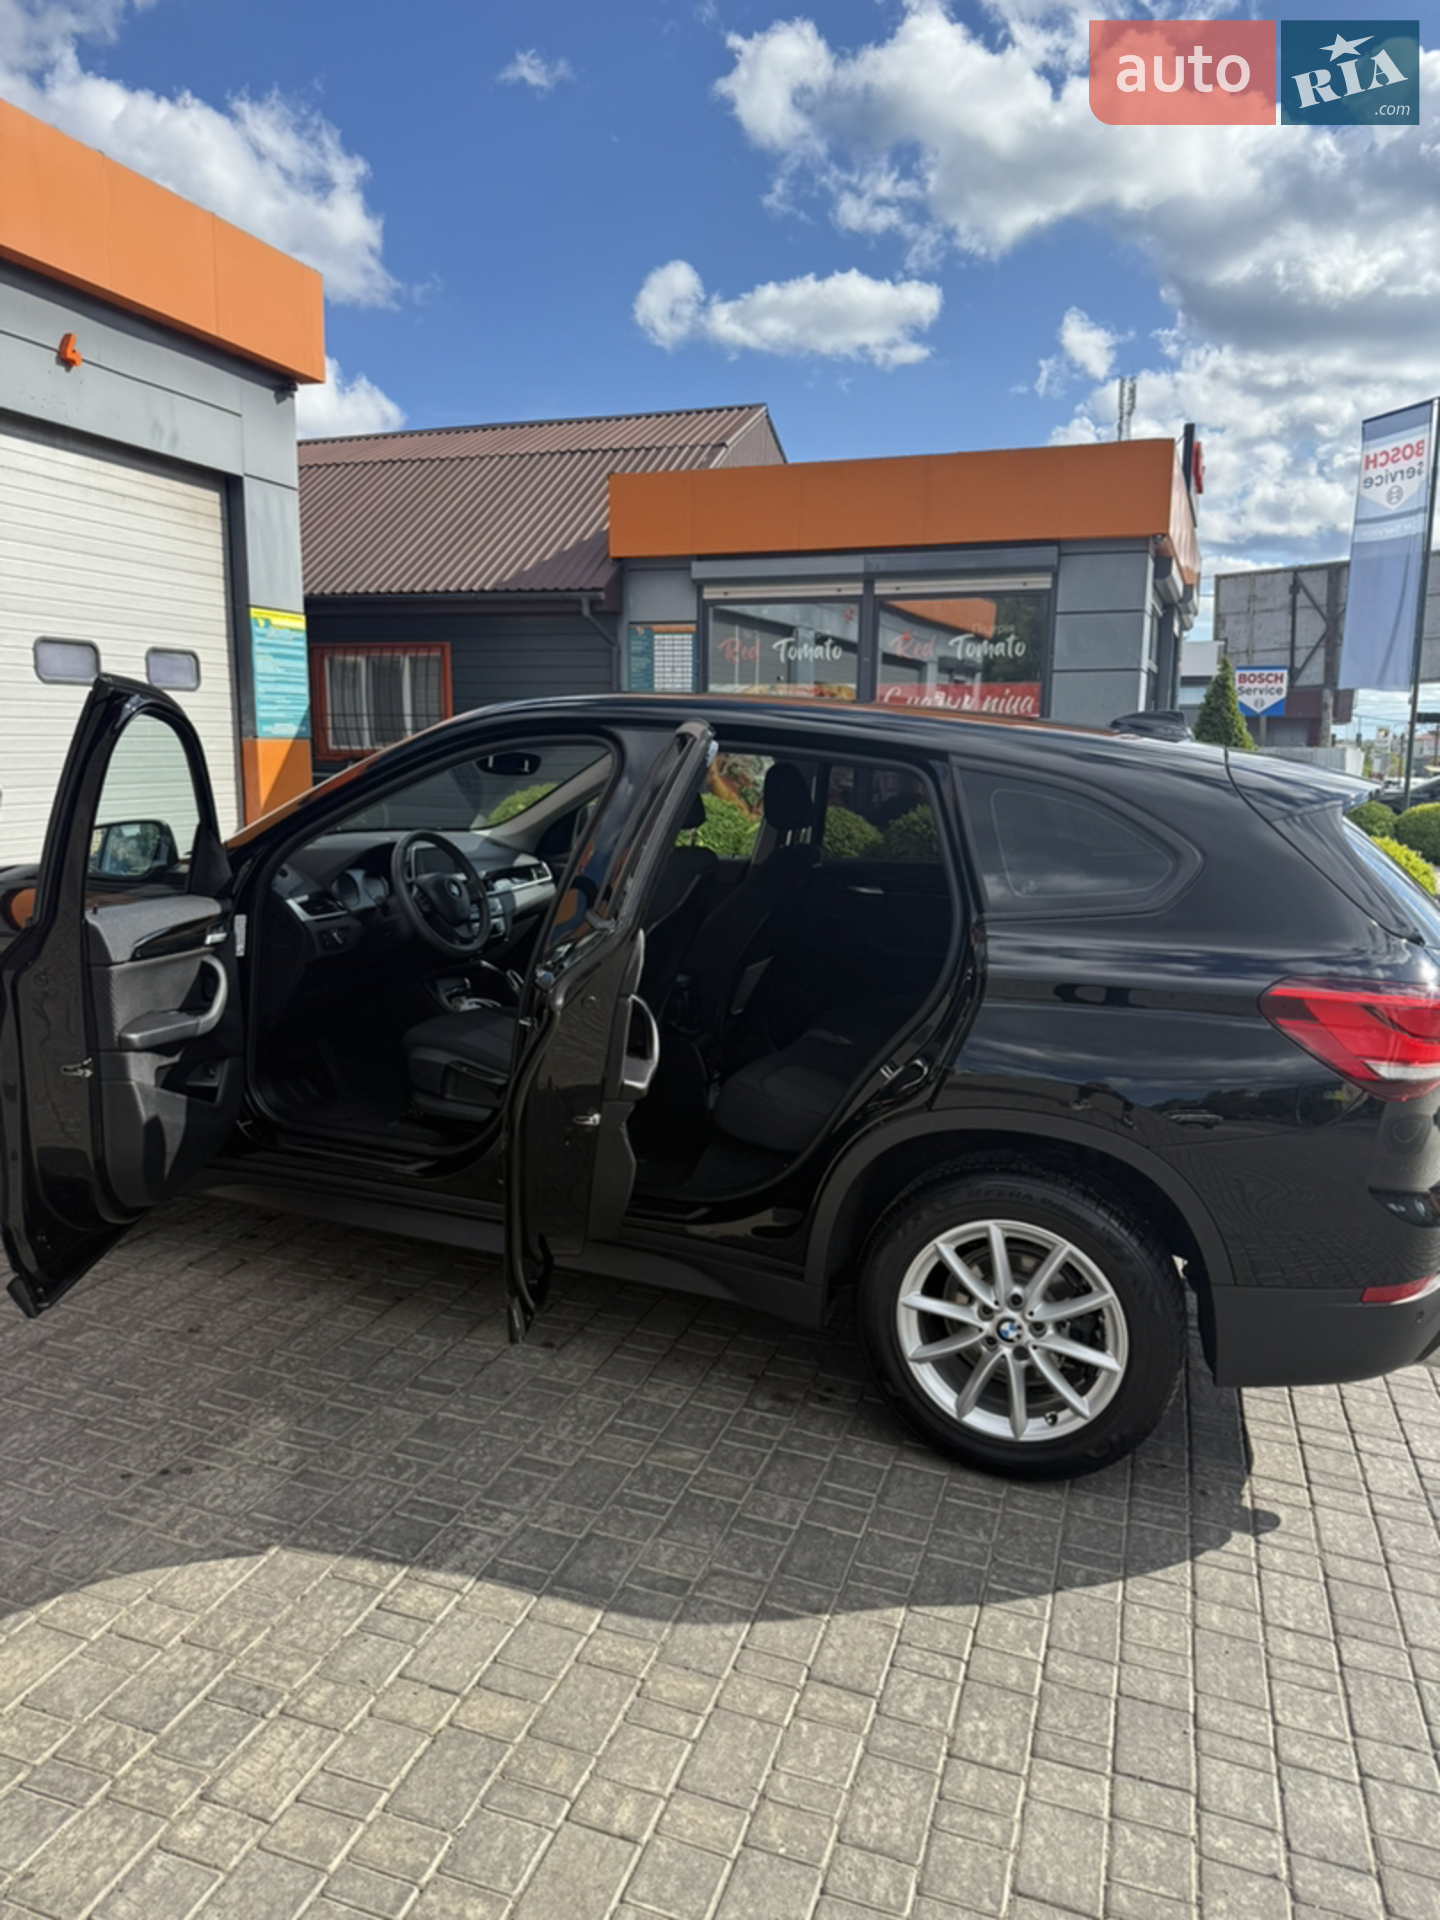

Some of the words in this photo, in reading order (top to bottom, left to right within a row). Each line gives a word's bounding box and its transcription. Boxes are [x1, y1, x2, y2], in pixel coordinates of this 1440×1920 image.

[718, 636, 760, 664] Red
[772, 637, 843, 664] Tomato
[888, 632, 937, 660] Red
[948, 632, 1027, 661] Tomato
[1238, 672, 1285, 684] BOSCH
[1237, 685, 1284, 696] Service
